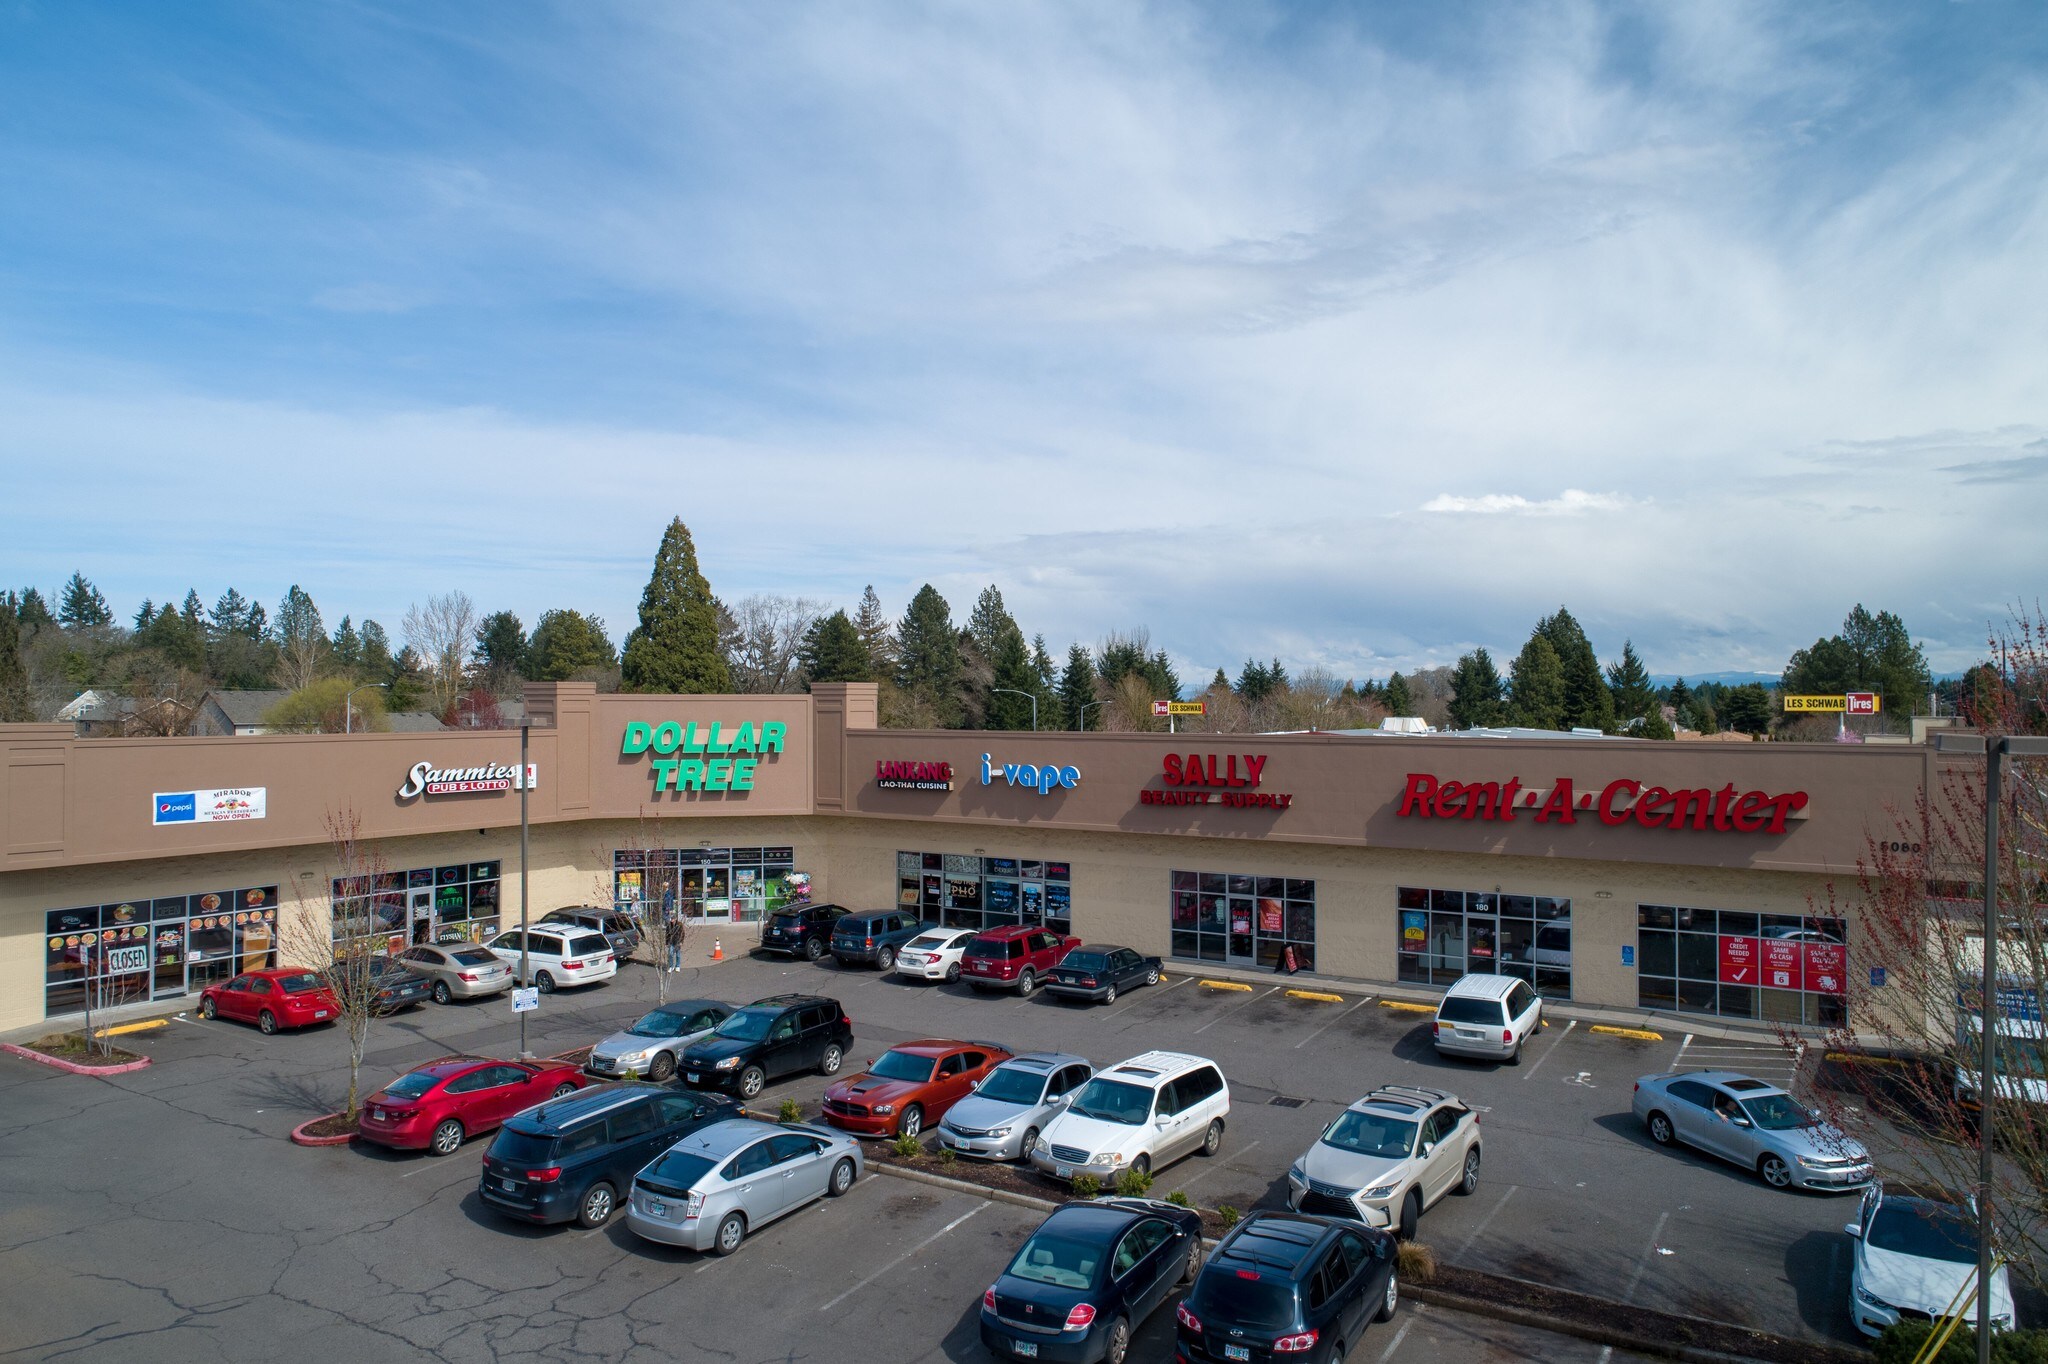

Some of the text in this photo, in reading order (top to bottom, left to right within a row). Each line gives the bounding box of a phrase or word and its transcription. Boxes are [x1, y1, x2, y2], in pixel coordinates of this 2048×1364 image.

[1155, 703, 1168, 714] Tires
[1787, 696, 1872, 711] LES SCHWAB Tires
[622, 720, 787, 755] DOLLAR
[652, 758, 758, 792] TREE
[876, 760, 951, 781] LANXANG
[981, 753, 1081, 795] i-vape
[1162, 753, 1267, 787] SALLY
[399, 761, 517, 798] Sammies
[432, 780, 506, 792] PUB & LOTTO
[880, 780, 947, 790] LAO-THAI CUISINE
[213, 789, 252, 799] MIRADOR
[1140, 789, 1293, 809] BEAUTY SUPPLY
[171, 803, 192, 812] pepsi
[1475, 903, 1489, 911] 180
[1771, 940, 1796, 948] MONTHS
[1728, 949, 1750, 957] NEEDED
[110, 949, 145, 971] CLOSED
[1778, 976, 1784, 984] 6
